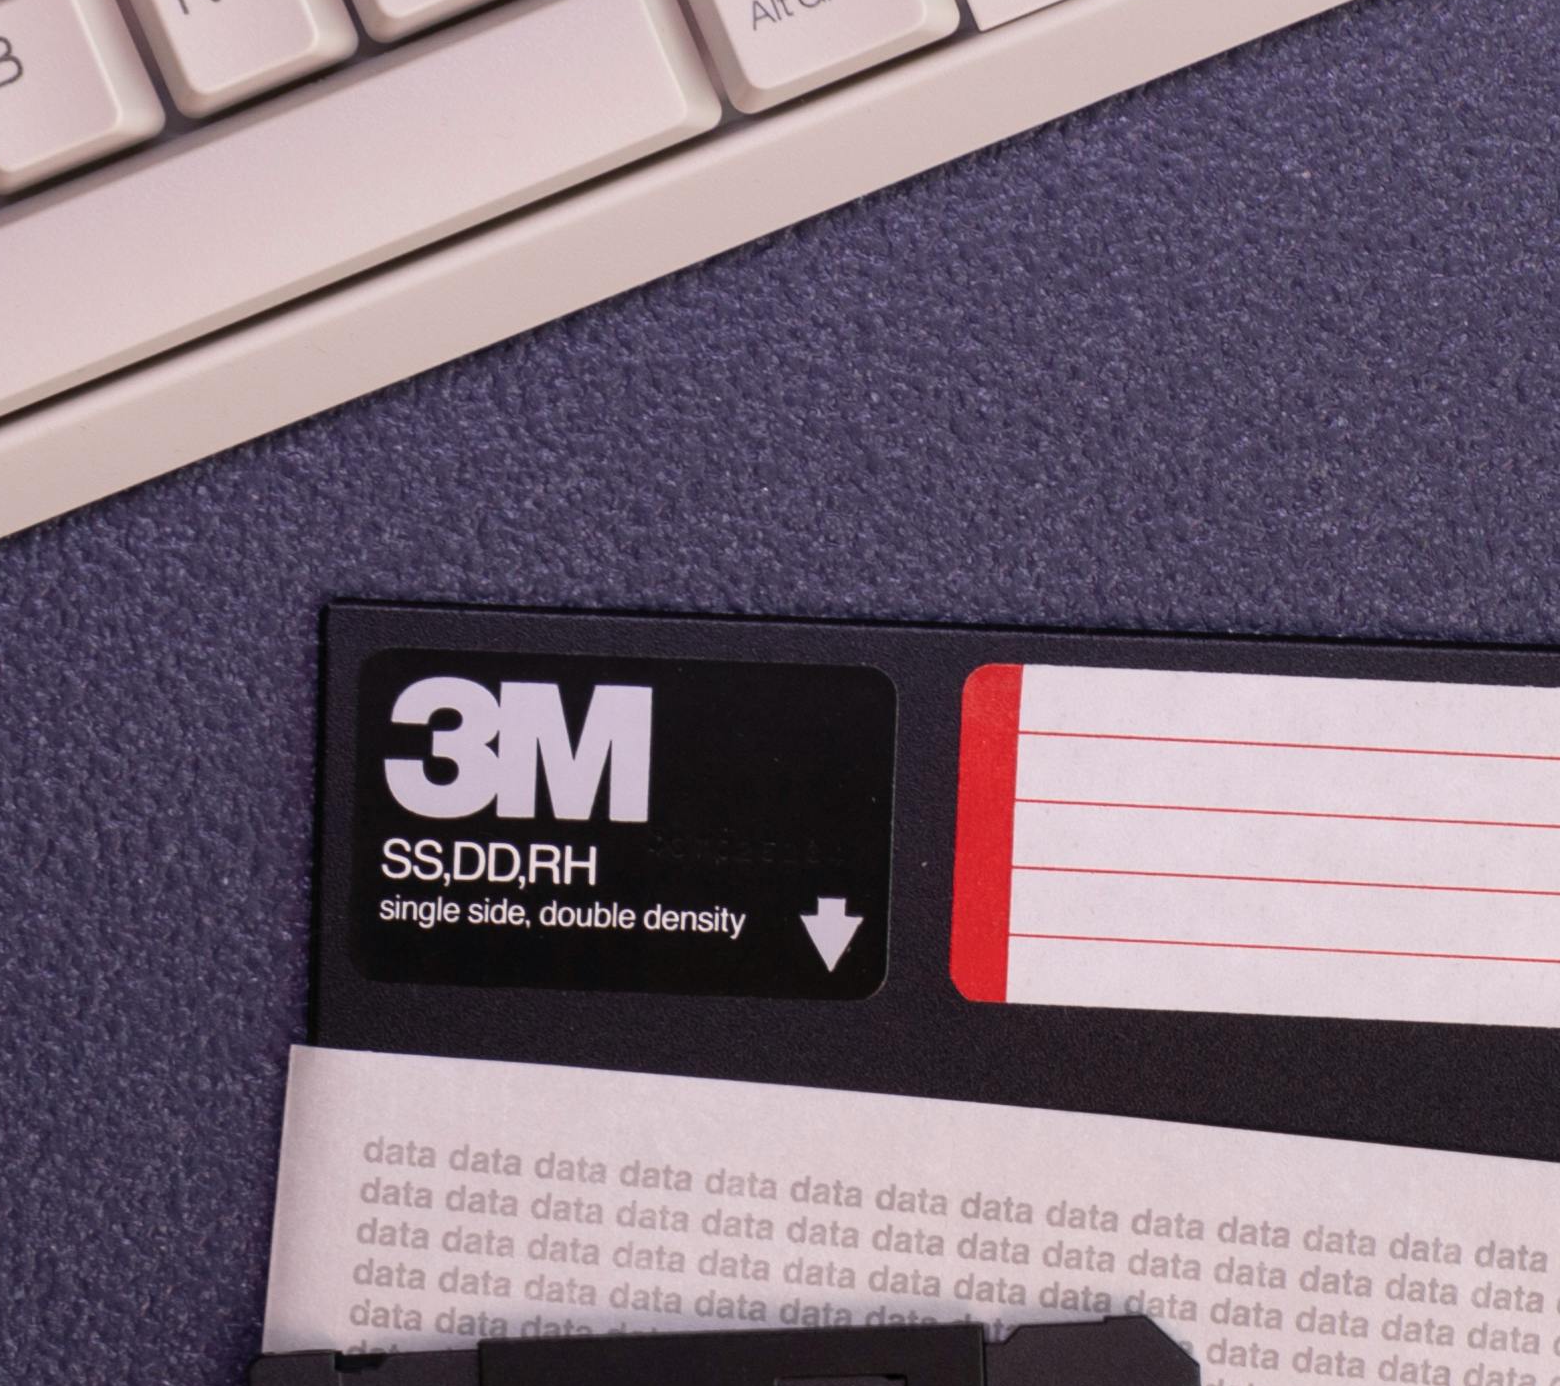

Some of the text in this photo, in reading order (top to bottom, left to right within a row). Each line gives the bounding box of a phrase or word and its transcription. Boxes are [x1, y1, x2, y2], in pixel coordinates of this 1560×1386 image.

[383, 676, 653, 823] 3M
[381, 838, 598, 891] SS,DD,RH
[379, 896, 746, 940] single side, double density
[362, 1136, 437, 1169] data
[447, 1144, 522, 1177] data
[533, 1152, 608, 1185] data
[618, 1160, 693, 1193] data
[704, 1168, 779, 1201] data
[789, 1176, 864, 1209] data
[874, 1184, 949, 1217] data
[960, 1192, 1035, 1225] data
[1045, 1200, 1120, 1233] data
[1131, 1208, 1206, 1241] data
[1216, 1215, 1291, 1249] data
[1301, 1223, 1376, 1256] data
[1387, 1231, 1462, 1264] data
[1472, 1239, 1547, 1272] data
